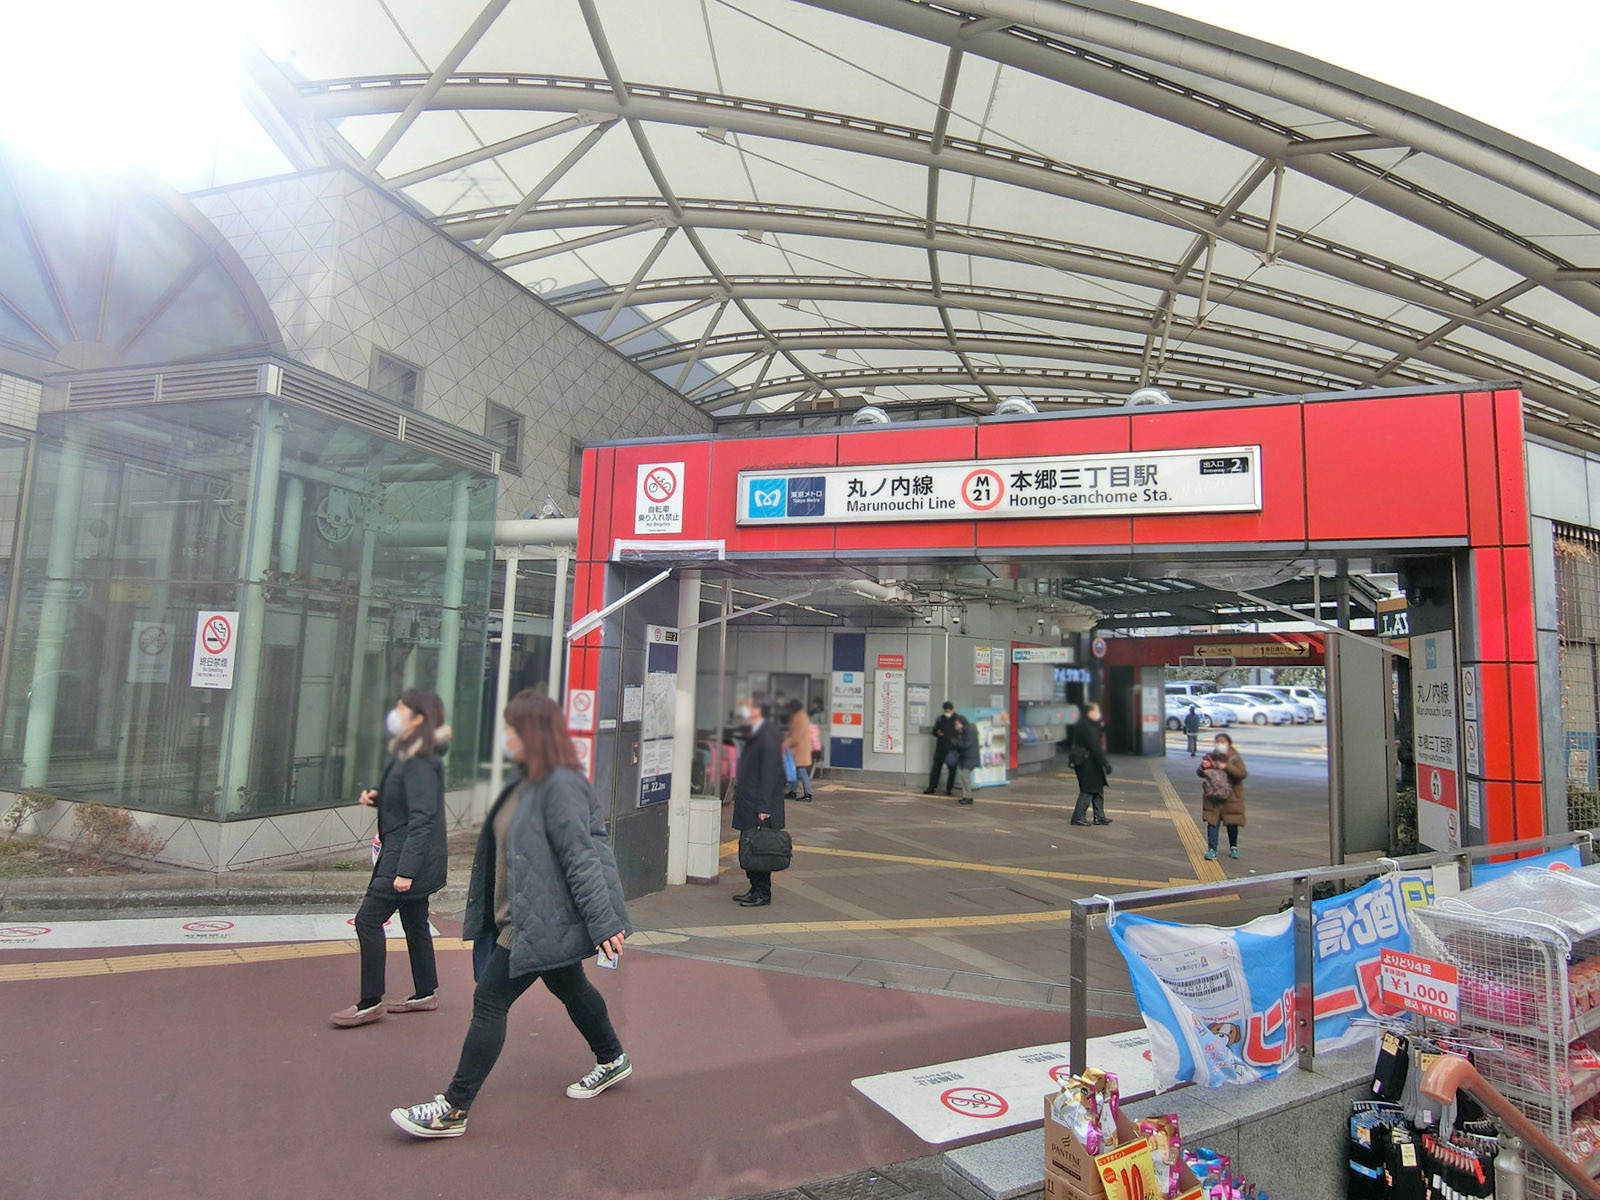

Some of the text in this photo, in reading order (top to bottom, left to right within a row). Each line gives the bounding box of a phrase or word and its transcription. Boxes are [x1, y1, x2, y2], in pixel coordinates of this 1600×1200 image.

[1203, 459, 1241, 472] 出入口 2
[847, 474, 934, 498] 丸ノ内線
[976, 475, 990, 488] M
[1010, 463, 1159, 492] 本郷三丁目駅
[791, 490, 823, 499] 東京メトロ
[972, 488, 991, 502] 21
[1009, 487, 1173, 509] Hongo-sanchome Sta.
[648, 505, 670, 514] 自転車
[846, 496, 956, 512] Marunouchi Line
[638, 512, 680, 522] 乗り入れ禁止
[199, 656, 229, 668] 終日禁煙
[1416, 681, 1450, 704] 丸ノ内線
[1417, 734, 1454, 755] 本郷三丁目駅
[1432, 782, 1440, 797] 21
[1383, 953, 1432, 975] よりどり4足
[1391, 976, 1449, 1005] ¥1,000
[1421, 1003, 1457, 1021] ¥1,100
[1051, 1143, 1080, 1166] PANTENE
